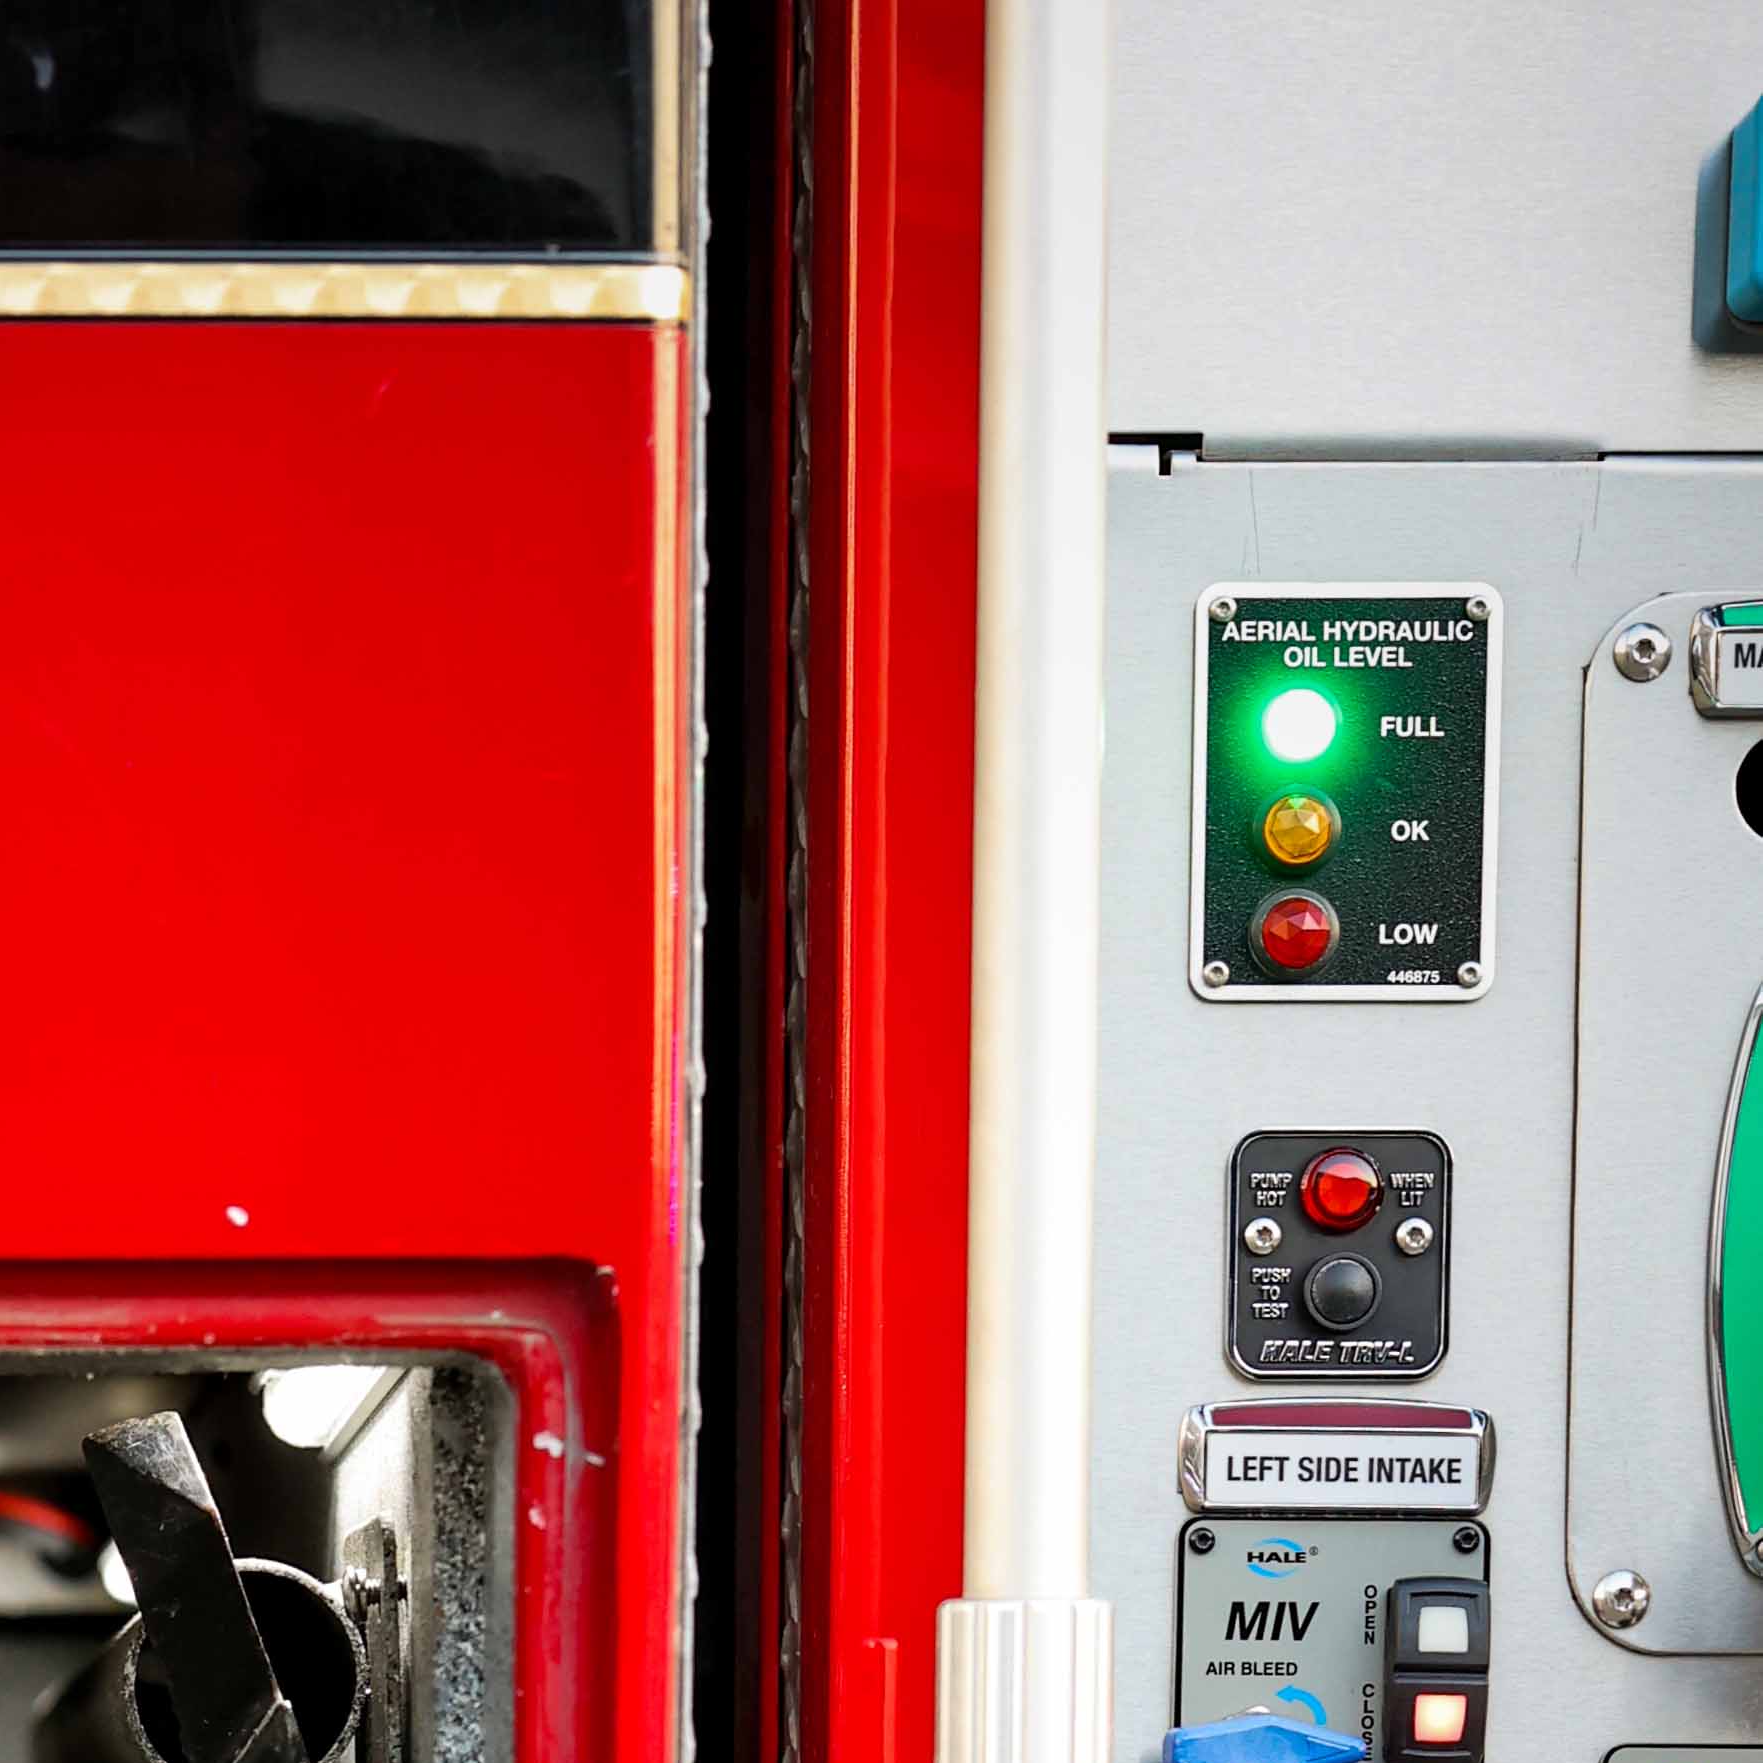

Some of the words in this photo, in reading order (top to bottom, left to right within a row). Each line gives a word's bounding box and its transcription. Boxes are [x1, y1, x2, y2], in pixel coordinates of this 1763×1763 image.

[1222, 620, 1316, 642] AERIAL
[1323, 620, 1474, 643] HYDRAULIC
[1283, 646, 1327, 668] OIL
[1333, 646, 1413, 668] LEVEL
[1380, 716, 1445, 737] FULL
[1390, 819, 1430, 842] OK
[1378, 923, 1438, 945] LOW
[1387, 970, 1440, 984] 446875
[1251, 1173, 1293, 1189] PUMP
[1390, 1173, 1435, 1189] WHEN
[1256, 1191, 1287, 1206] HOT
[1401, 1191, 1425, 1206] LIT
[1252, 1268, 1292, 1283] PUSH
[1261, 1285, 1281, 1301] TO
[1252, 1303, 1289, 1319] TEST
[1260, 1340, 1334, 1363] HALE
[1227, 1456, 1289, 1482] LEFT
[1298, 1456, 1359, 1483] SIDE
[1367, 1457, 1462, 1484] INTAKE
[1225, 1601, 1320, 1641] MIV
[1364, 1584, 1377, 1645] OPEN
[1206, 1662, 1235, 1676] AIR
[1241, 1662, 1298, 1676] BLEED
